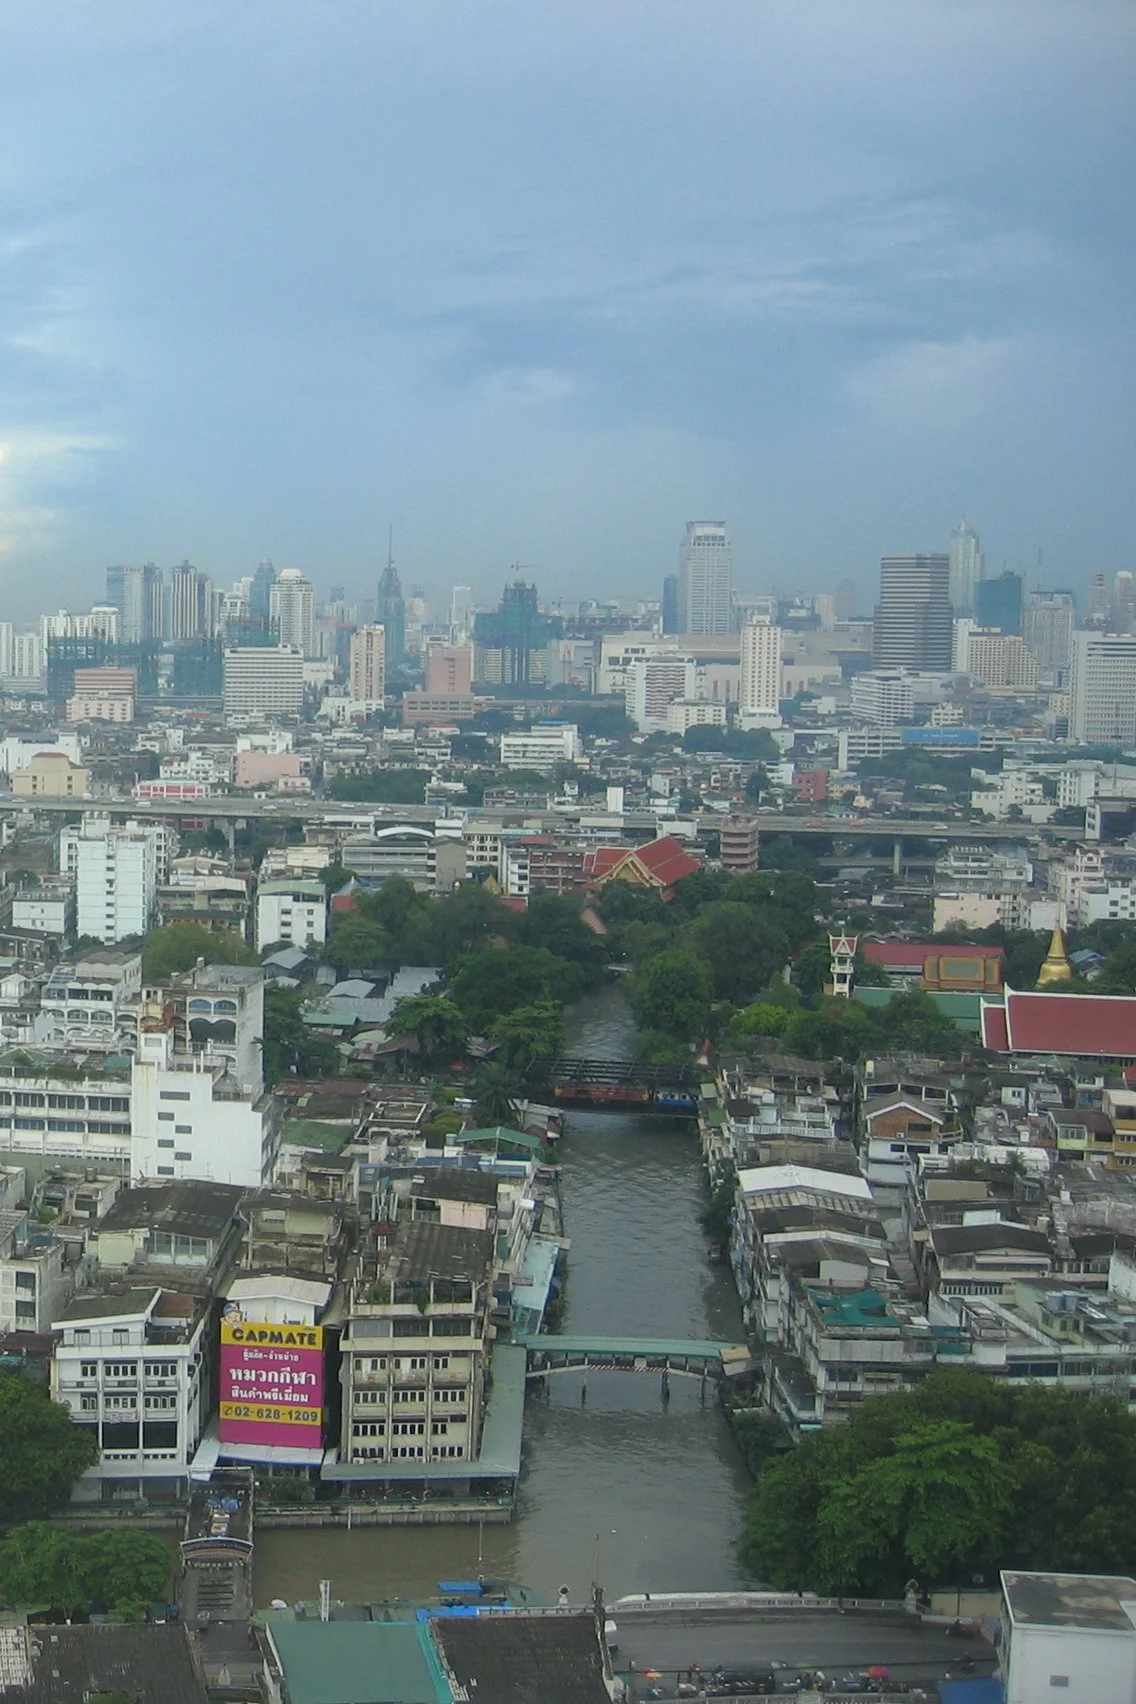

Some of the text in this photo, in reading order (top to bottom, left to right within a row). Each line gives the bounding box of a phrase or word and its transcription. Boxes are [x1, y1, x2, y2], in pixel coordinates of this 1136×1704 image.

[231, 1328, 317, 1346] CAPMATE
[229, 1366, 317, 1386] หมวกกีฬา
